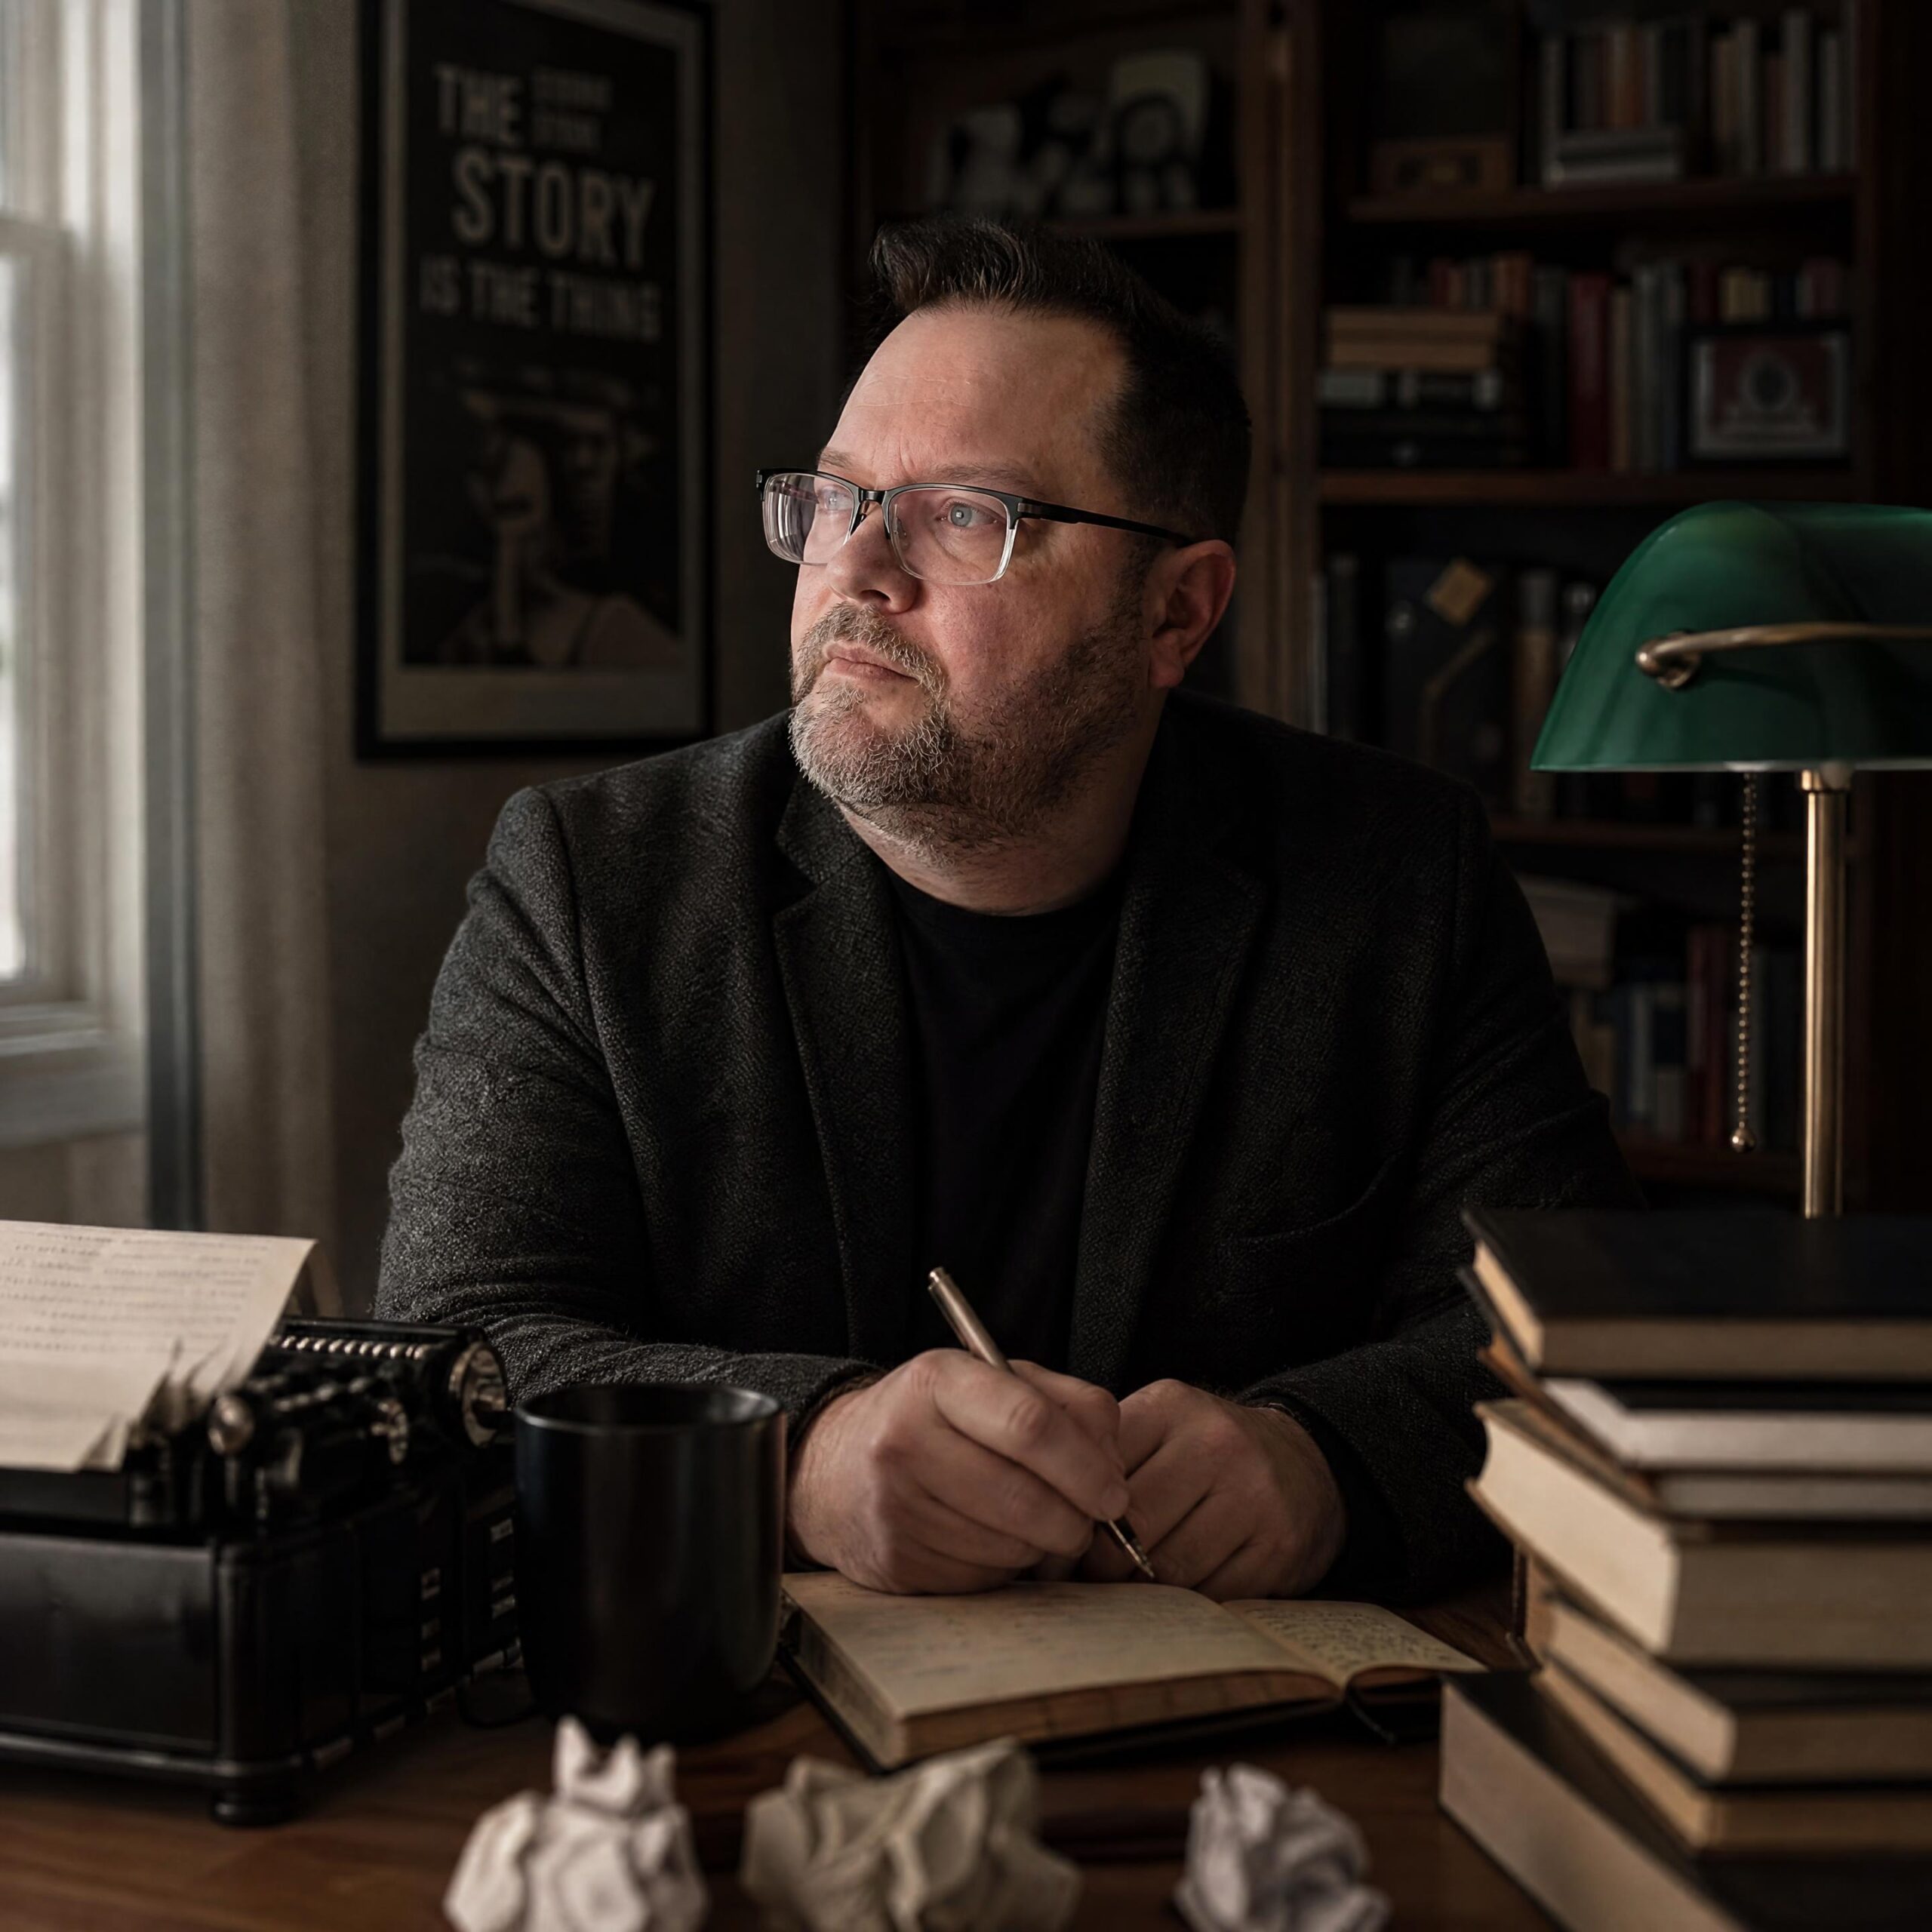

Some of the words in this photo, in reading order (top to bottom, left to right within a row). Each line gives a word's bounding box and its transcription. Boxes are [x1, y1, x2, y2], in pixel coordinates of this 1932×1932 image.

[435, 63, 525, 146] THE
[454, 146, 656, 271] STORY
[420, 256, 460, 315] IS
[468, 260, 539, 328] THE
[546, 269, 661, 343] THING
